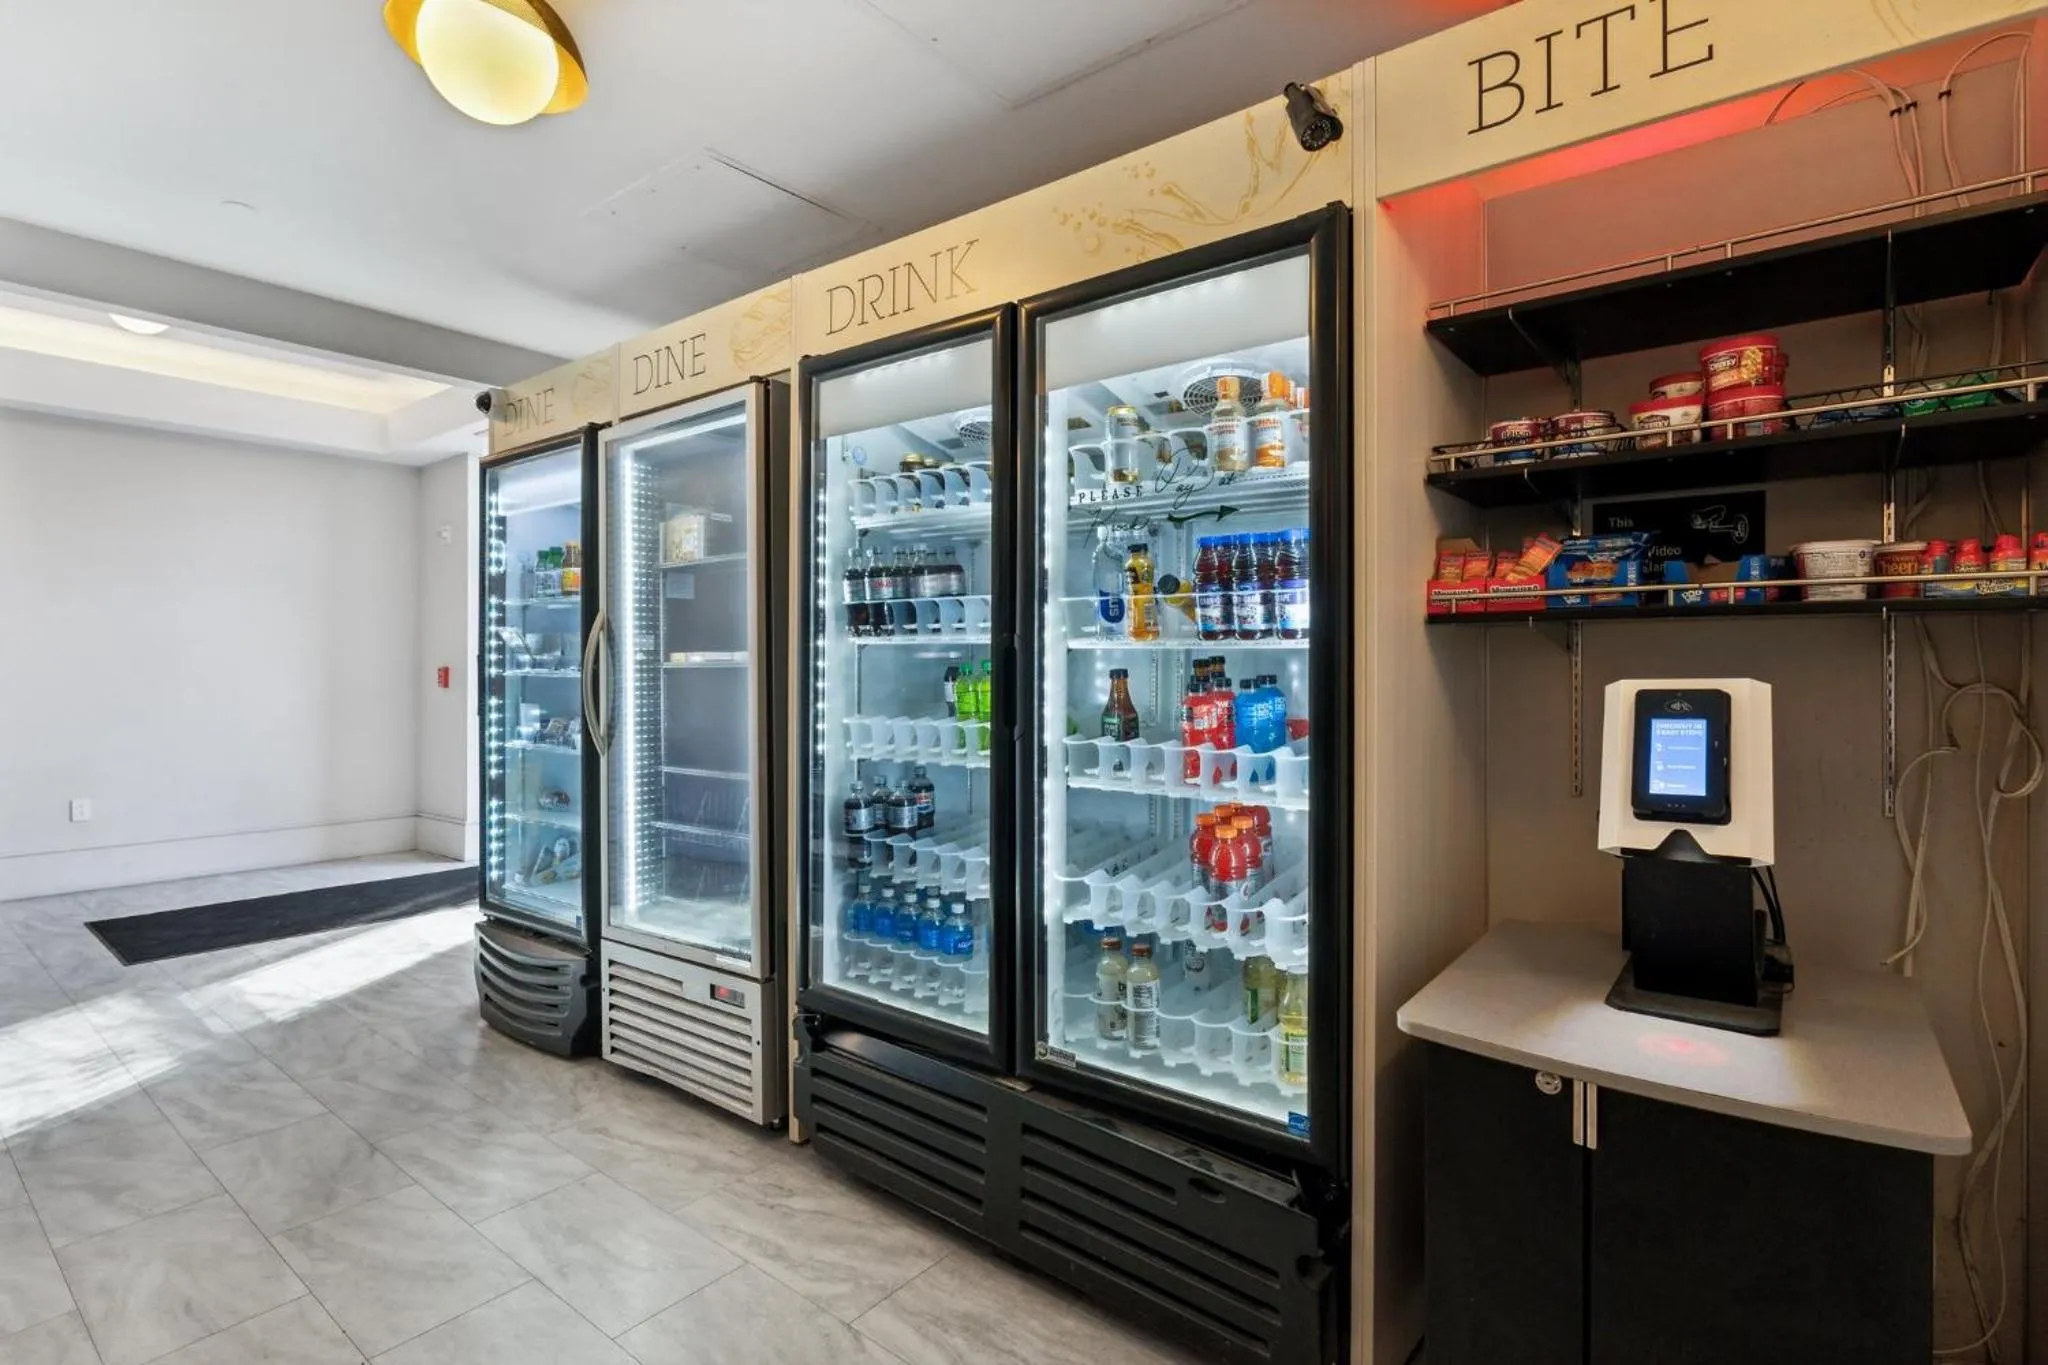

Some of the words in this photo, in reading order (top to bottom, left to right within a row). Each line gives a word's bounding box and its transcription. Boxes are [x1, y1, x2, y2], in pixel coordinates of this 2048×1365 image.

[1468, 0, 1713, 135] BITE
[826, 238, 980, 336] DRINK
[633, 333, 706, 395] DINE
[504, 387, 555, 436] DINE
[1078, 483, 1144, 503] PLEASE
[1608, 516, 1635, 528] This
[1647, 545, 1682, 557] Video
